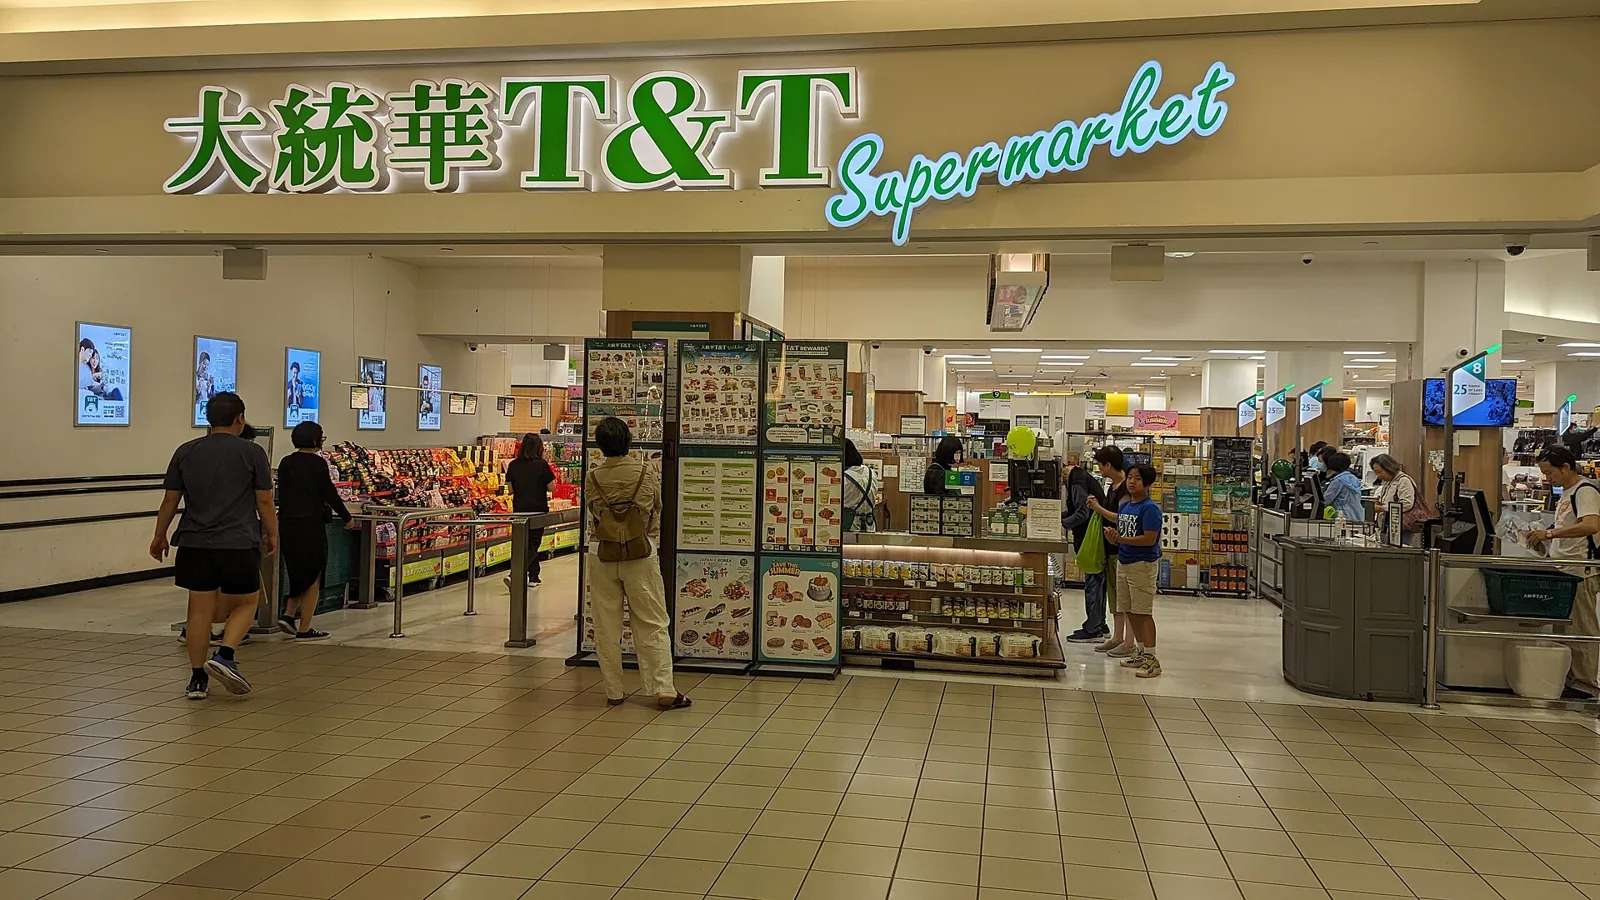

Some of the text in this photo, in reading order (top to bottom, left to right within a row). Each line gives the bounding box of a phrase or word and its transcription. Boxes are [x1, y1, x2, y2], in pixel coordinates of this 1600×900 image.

[828, 63, 1235, 243] Supermarket
[1472, 363, 1482, 374] 8
[1313, 390, 1320, 398] 7
[1453, 384, 1468, 395] 25
[1301, 403, 1311, 411] 25
[769, 566, 800, 577] SUMMER
